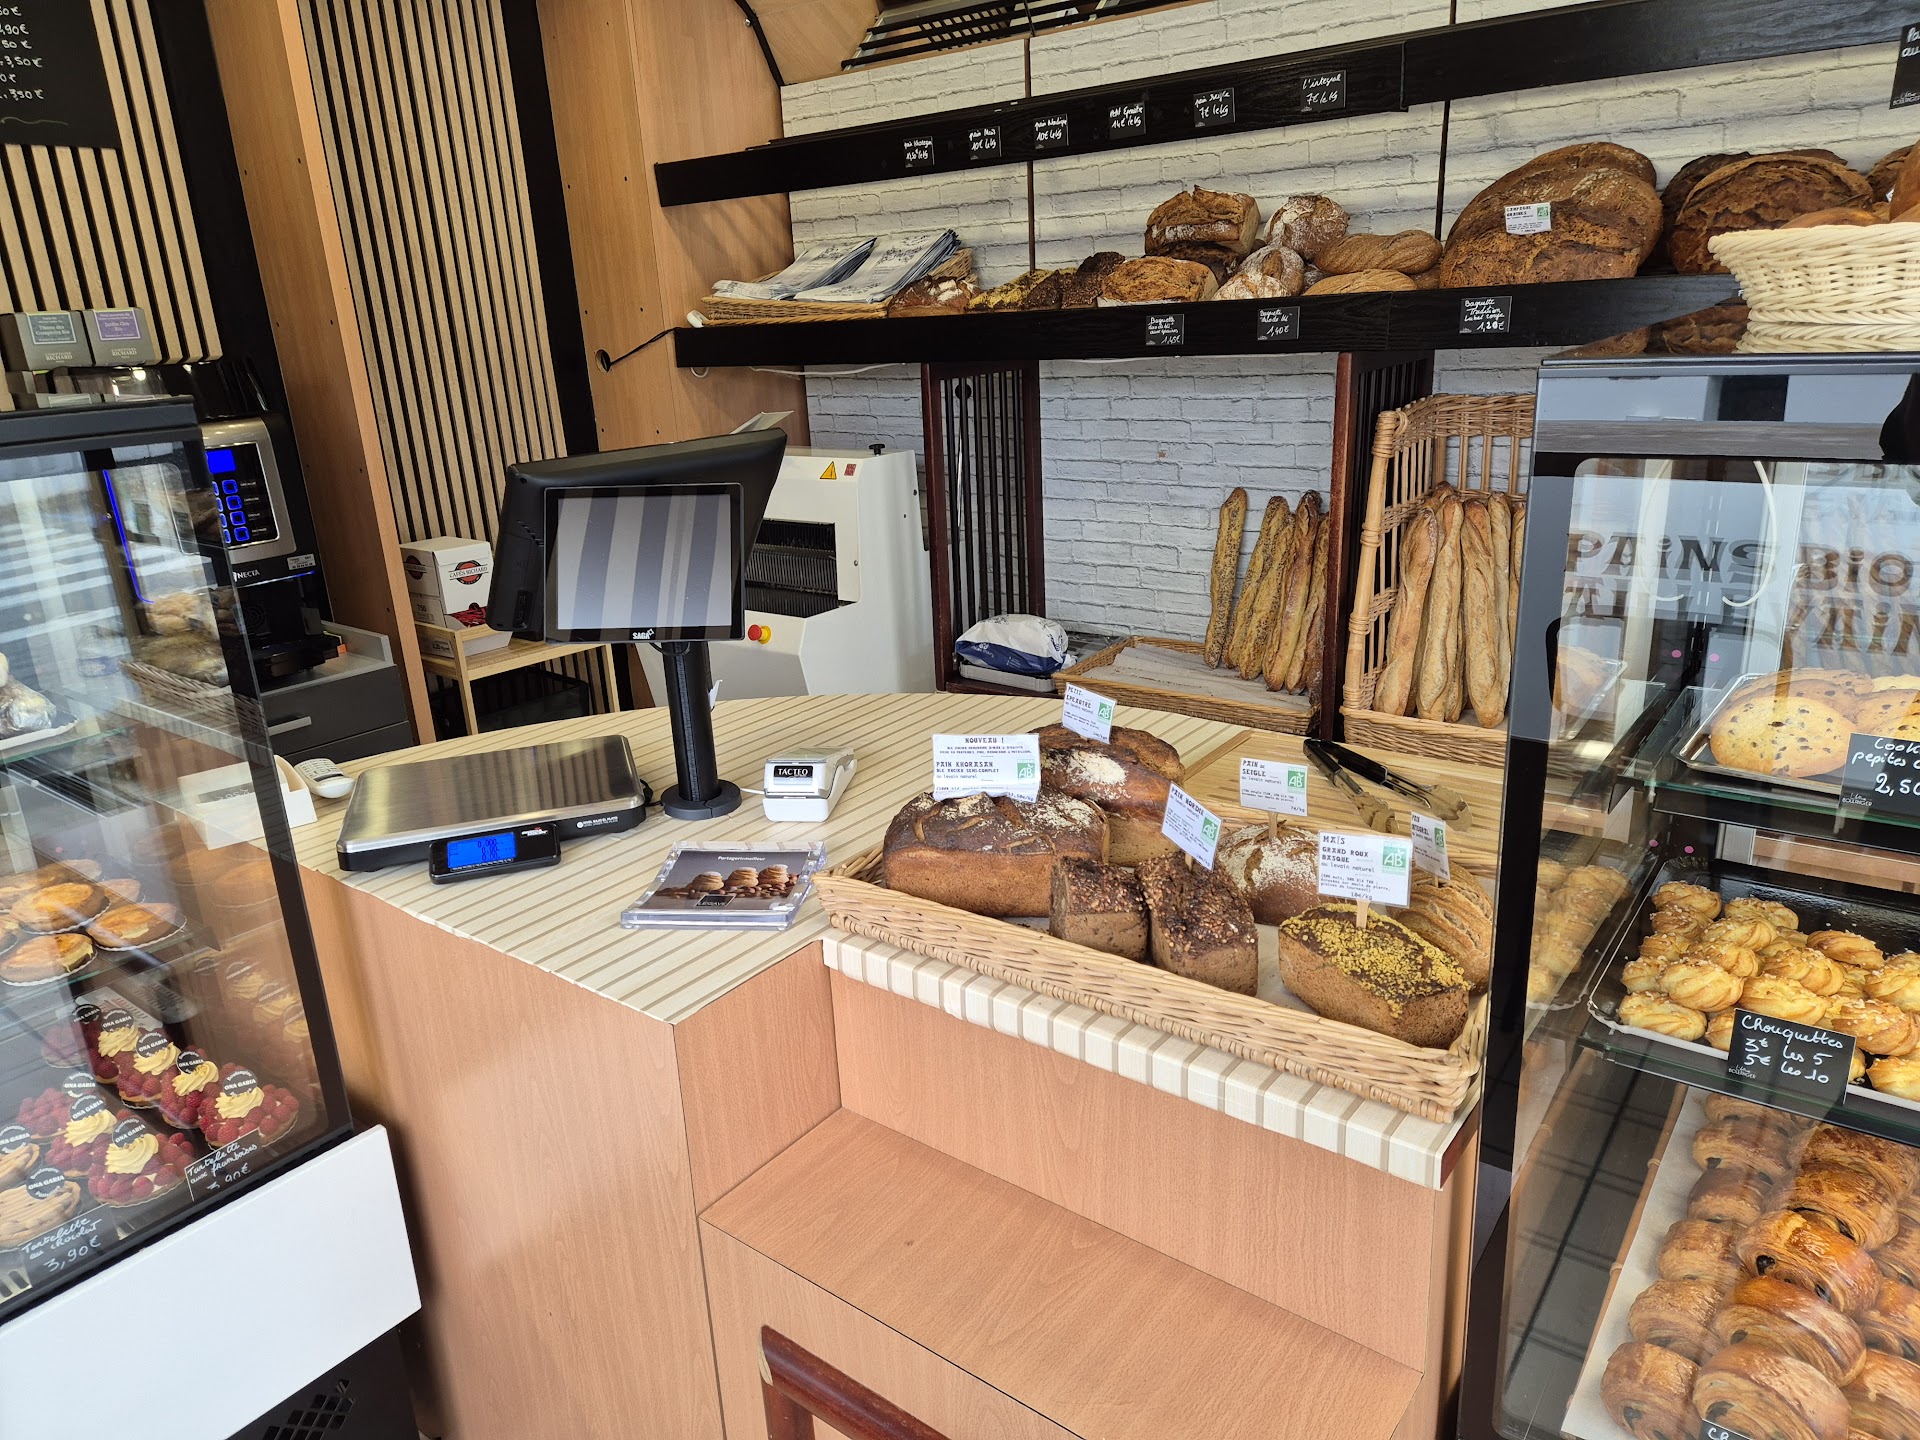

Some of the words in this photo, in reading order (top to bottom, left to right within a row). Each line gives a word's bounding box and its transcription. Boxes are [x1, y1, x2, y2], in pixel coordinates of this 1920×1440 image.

[0, 23, 29, 35] ,90€
[237, 570, 260, 579] NECTA
[1874, 737, 1920, 754] Cook
[778, 768, 808, 776] TACTEO
[1242, 769, 1266, 777] SEIGLE
[1289, 776, 1303, 788] AB
[1322, 836, 1345, 845] MAÏS
[1322, 846, 1346, 854] GRAND
[1322, 855, 1350, 863] BASQUE
[1384, 853, 1403, 866] AB
[1741, 1015, 1844, 1049] Chouquettes
[1745, 1037, 1769, 1052] 3€
[1813, 1052, 1833, 1065] 5
[1743, 1054, 1771, 1066] 5€
[1804, 1069, 1829, 1084] 10
[28, 1182, 43, 1190] ONA
[21, 1218, 91, 1253] Tartelette
[43, 1235, 101, 1272] 3,90€
